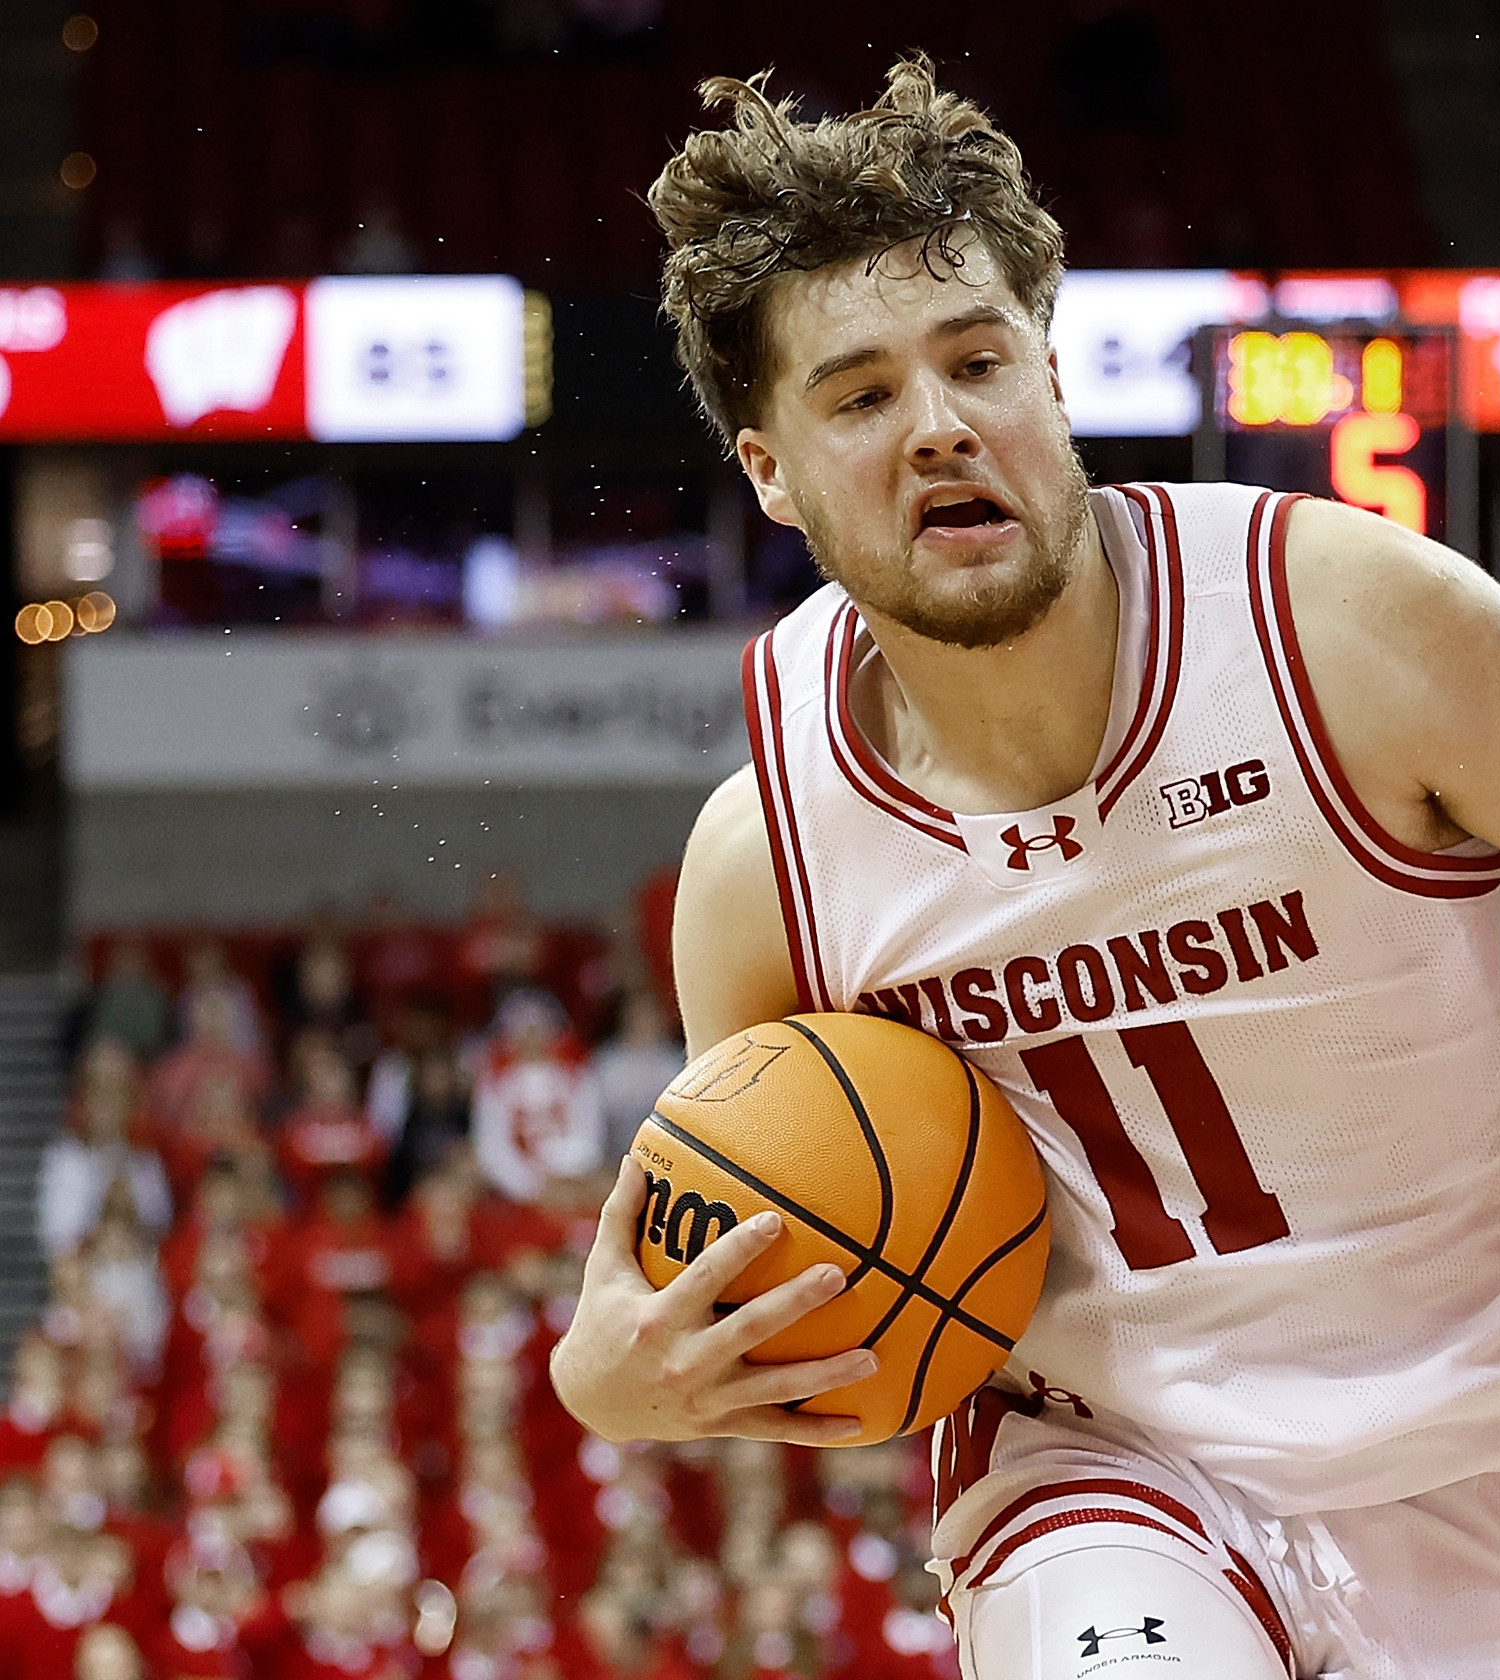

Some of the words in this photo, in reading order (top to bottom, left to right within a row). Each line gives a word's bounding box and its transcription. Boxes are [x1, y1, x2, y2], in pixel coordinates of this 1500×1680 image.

[1018, 1020, 1291, 1271] 11
[1076, 1657, 1118, 1679] UNDER
[1120, 1653, 1182, 1663] ARMOUR
